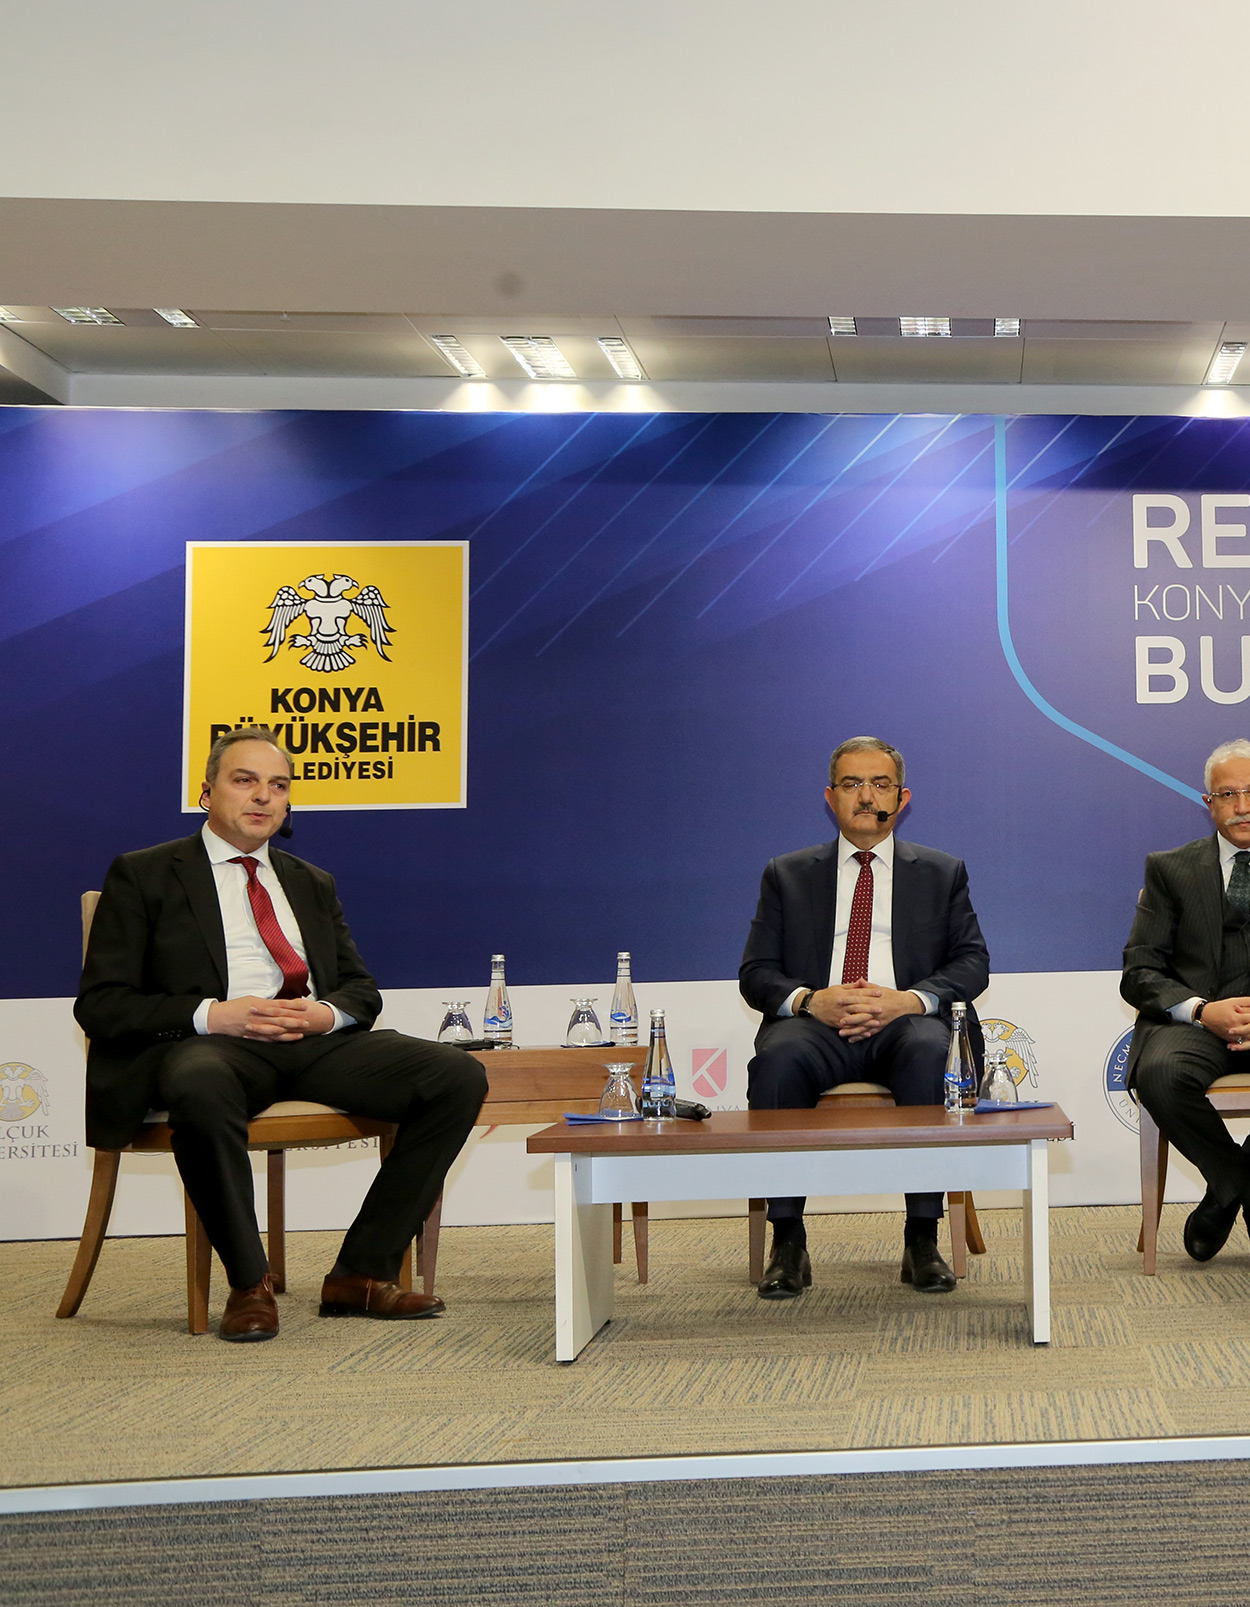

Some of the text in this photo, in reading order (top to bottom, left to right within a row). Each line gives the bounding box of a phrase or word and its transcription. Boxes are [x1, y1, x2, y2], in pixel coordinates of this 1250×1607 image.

[270, 687, 384, 713] KONYA
[210, 714, 441, 758] ÜKŞEHİR
[291, 756, 393, 780] LEDİYESİ
